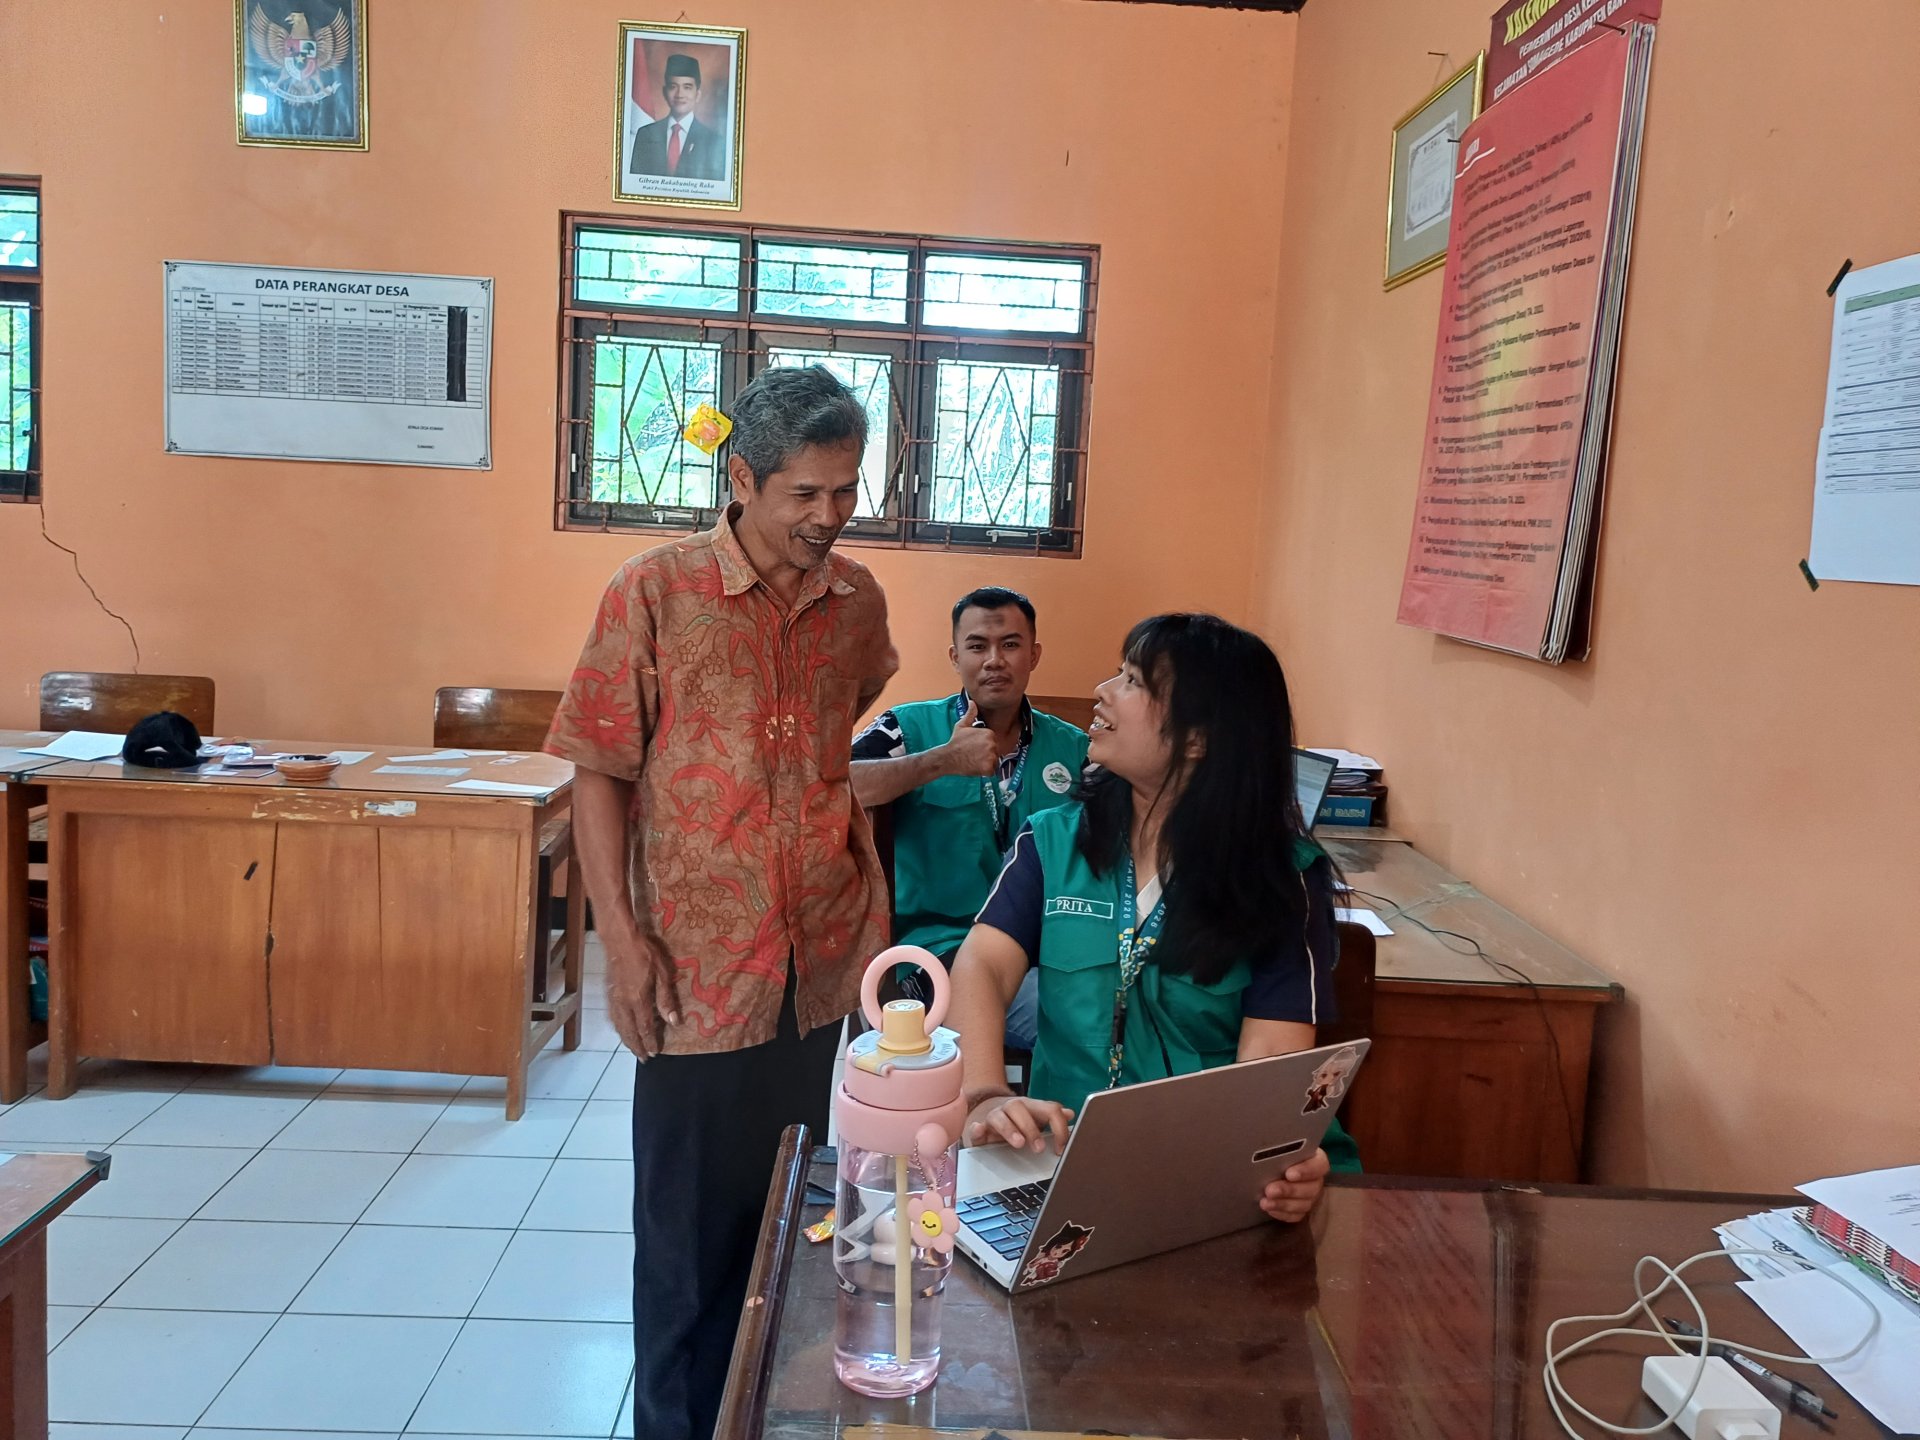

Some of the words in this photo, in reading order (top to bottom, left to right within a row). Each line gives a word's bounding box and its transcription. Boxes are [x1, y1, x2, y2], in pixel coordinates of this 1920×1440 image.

[1519, 17, 1564, 60] PEMERINTAH
[1564, 2, 1582, 29] DESA
[255, 278, 289, 291] DATA
[293, 280, 373, 295] PERANGKAT
[375, 285, 410, 297] DESA
[1056, 899, 1093, 913] PRITA
[1122, 892, 1133, 919] 2026
